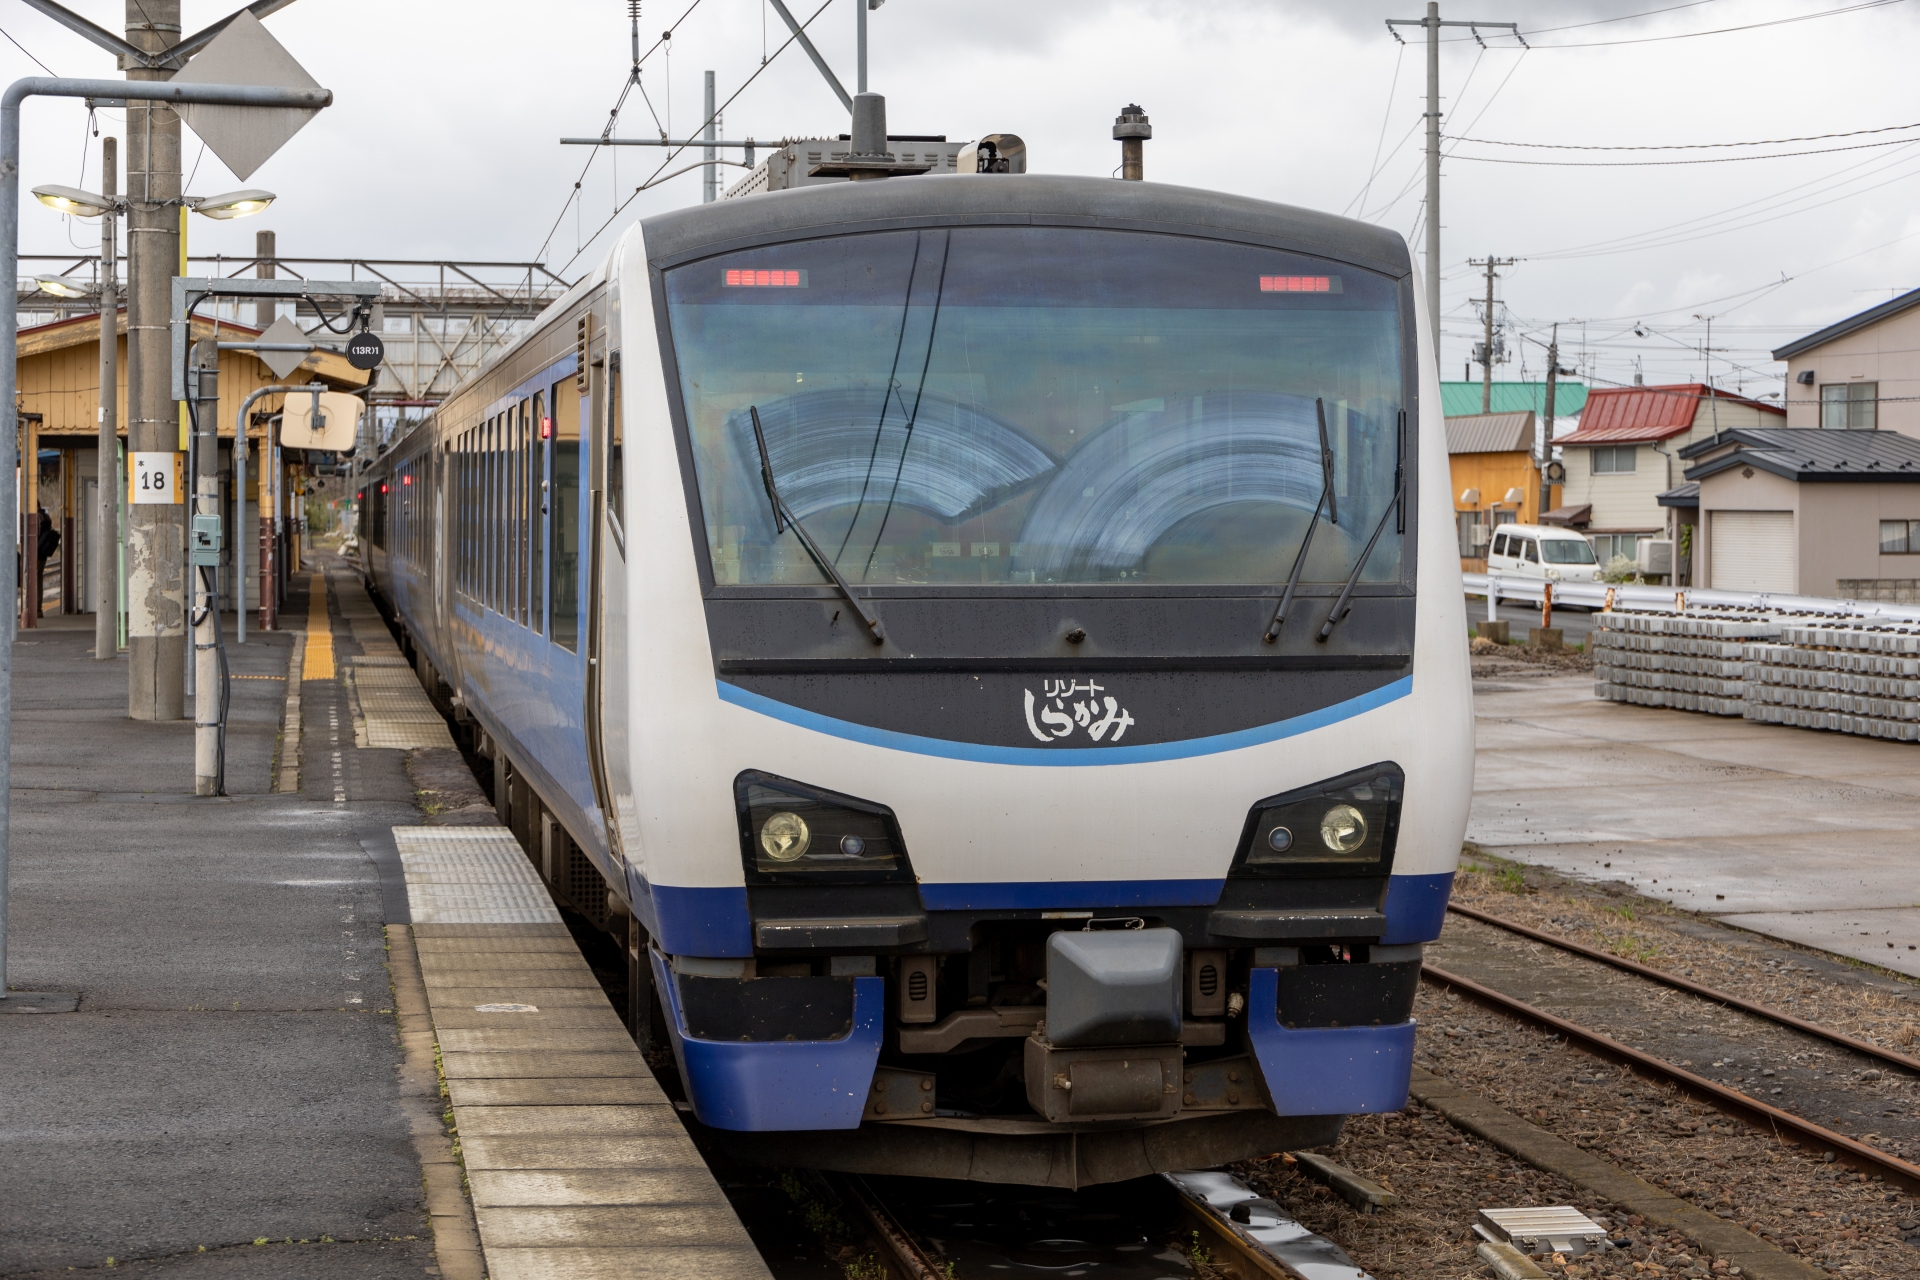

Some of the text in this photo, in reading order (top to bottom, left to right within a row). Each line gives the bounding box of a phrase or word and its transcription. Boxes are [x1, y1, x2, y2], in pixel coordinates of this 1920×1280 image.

[352, 346, 379, 355] (13R)1
[141, 471, 165, 490] 18
[1044, 678, 1105, 698] リゾート
[1024, 687, 1135, 742] しらかみ
